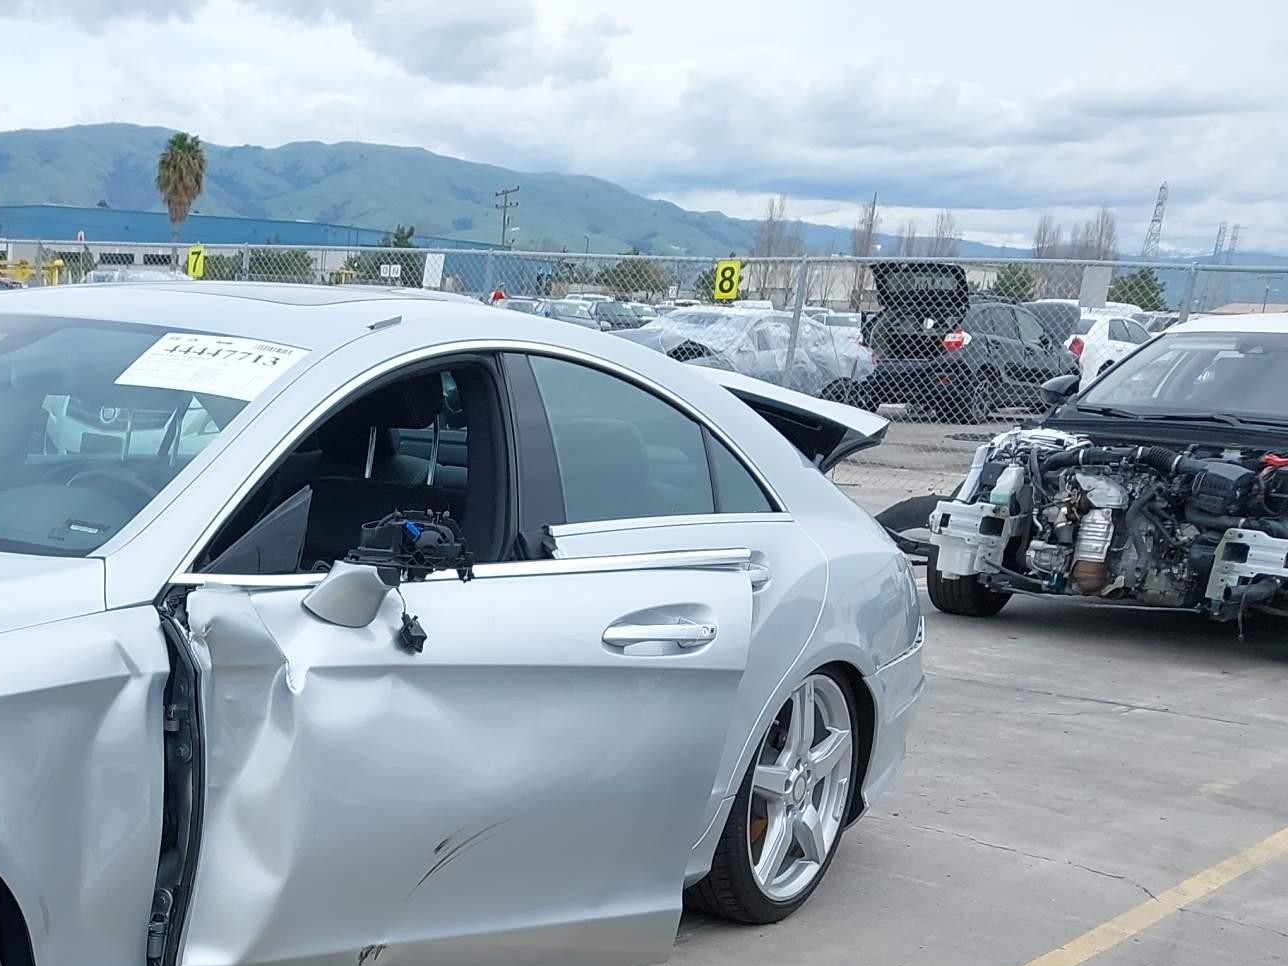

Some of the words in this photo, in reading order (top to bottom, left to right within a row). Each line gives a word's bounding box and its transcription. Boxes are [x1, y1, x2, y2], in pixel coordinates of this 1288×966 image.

[191, 250, 202, 273] 7
[719, 266, 735, 293] 8
[165, 345, 281, 367] 44447713
